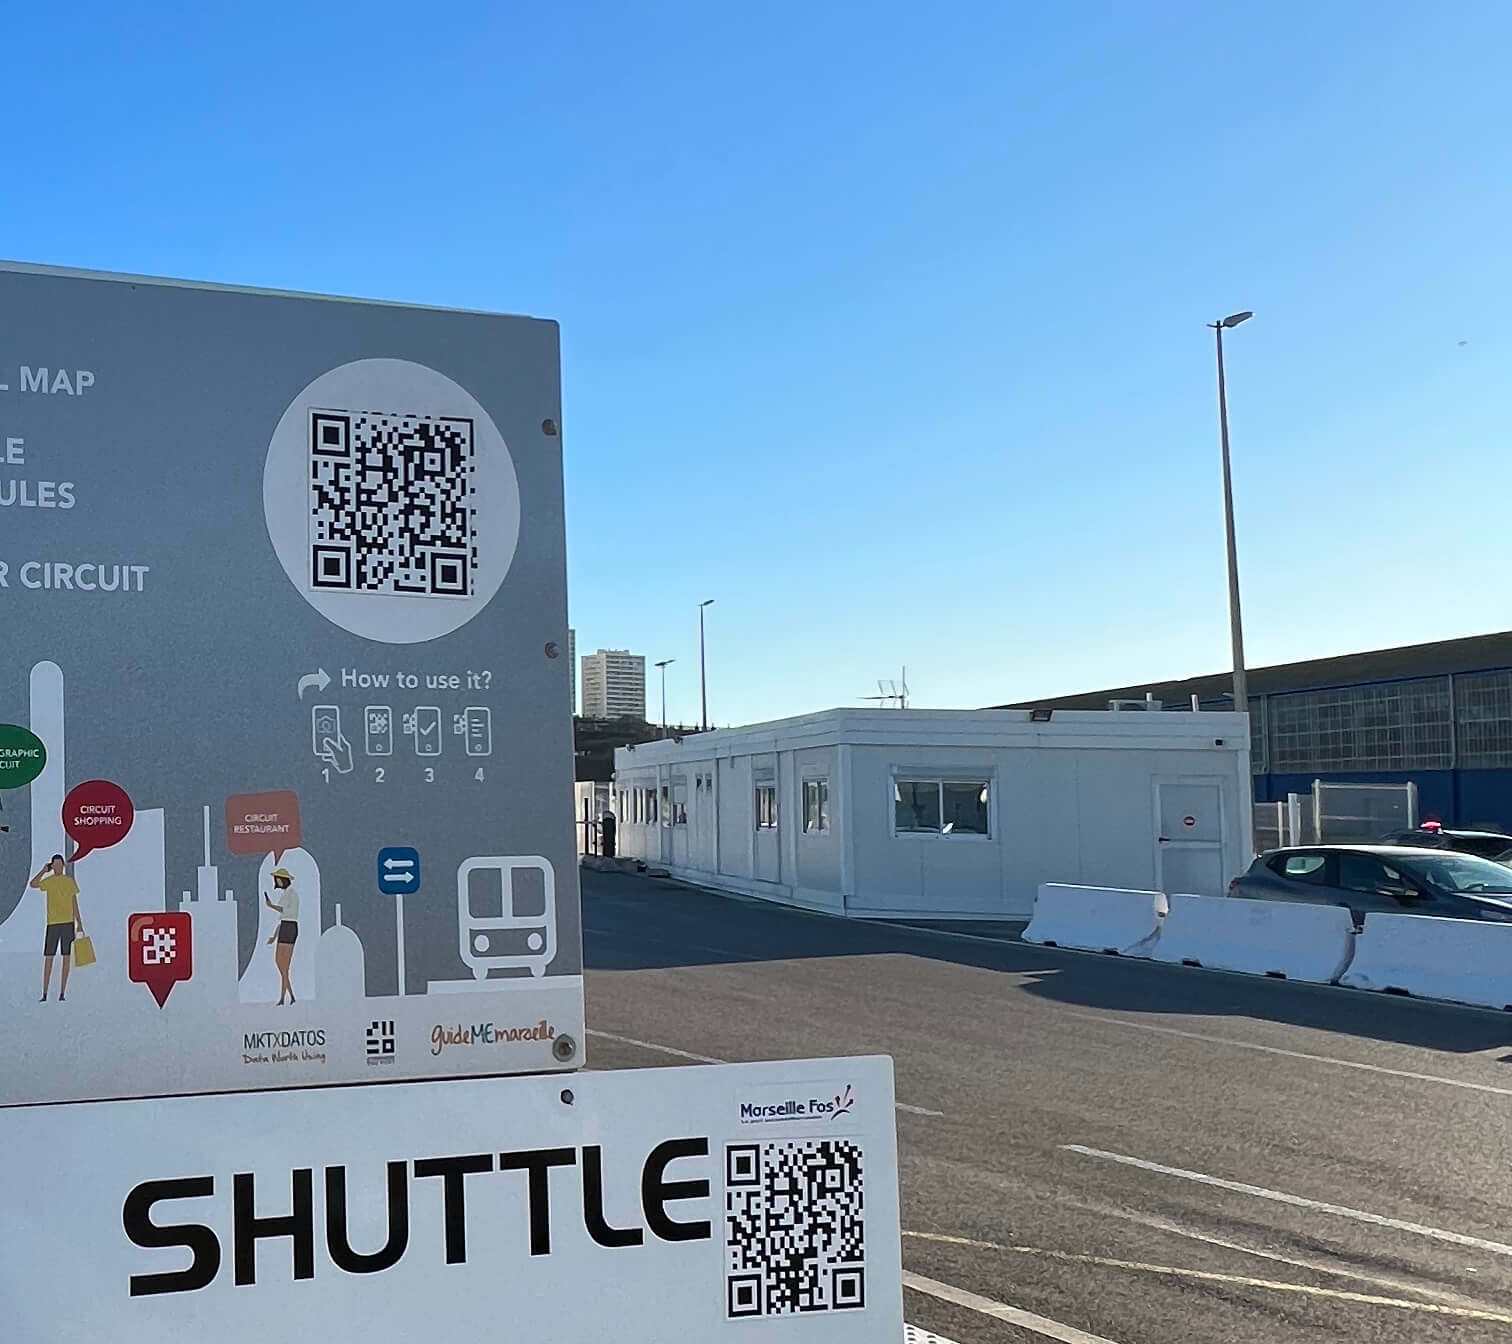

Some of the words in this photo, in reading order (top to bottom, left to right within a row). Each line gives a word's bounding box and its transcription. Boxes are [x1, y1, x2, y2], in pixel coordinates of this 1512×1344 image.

[19, 365, 96, 396] MAP
[19, 561, 150, 592] CIRCUIT
[341, 668, 389, 688] How
[396, 671, 419, 689] to
[425, 674, 461, 689] use
[466, 670, 493, 690] it?
[321, 768, 330, 784] 1
[375, 767, 385, 783] 2
[424, 767, 435, 783] 3
[474, 767, 485, 783] 4
[79, 805, 116, 815] CIRCUIT
[244, 813, 279, 823] CIRCUIT
[74, 816, 122, 826] SHOPPING
[233, 824, 289, 834] RESTAURANT
[244, 1029, 326, 1049] MKTXDATOS
[242, 1053, 269, 1064] Data
[740, 1100, 805, 1118] Marseille
[808, 1099, 834, 1114] Fos
[122, 1137, 712, 1297] SHUTTLE
